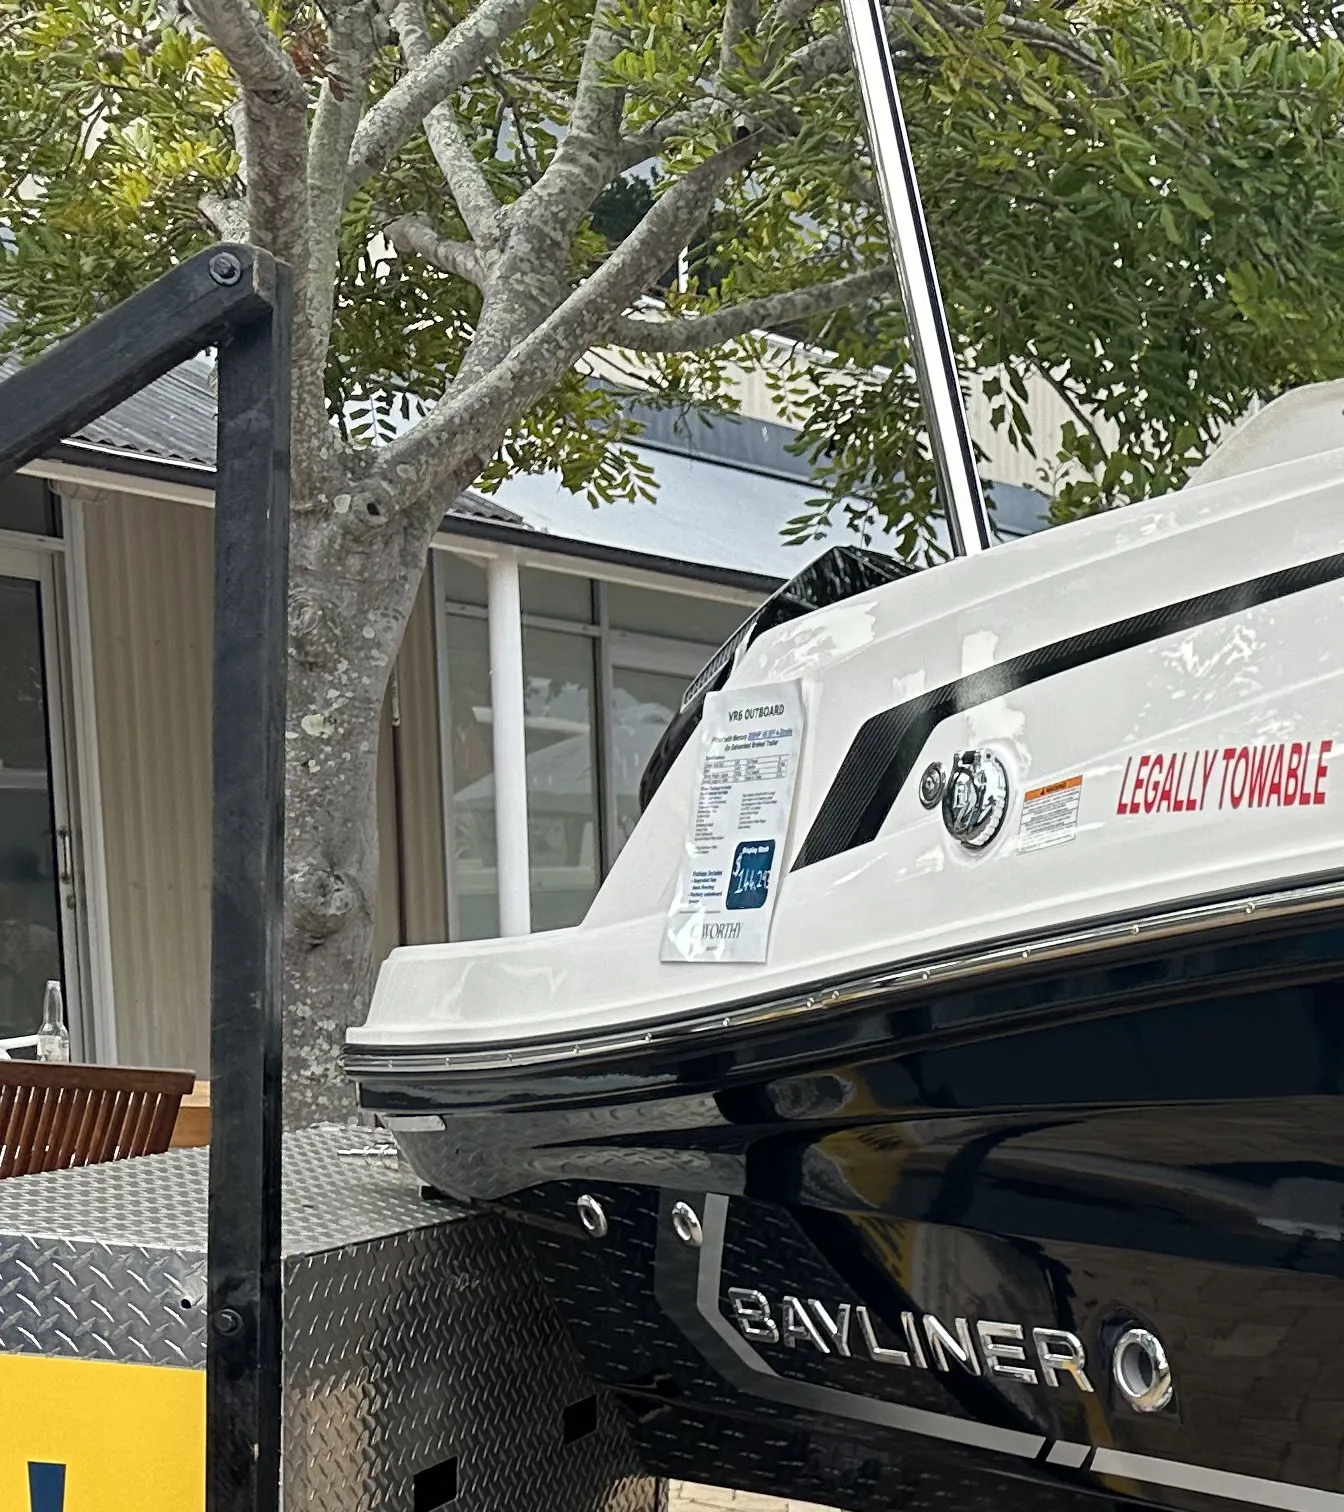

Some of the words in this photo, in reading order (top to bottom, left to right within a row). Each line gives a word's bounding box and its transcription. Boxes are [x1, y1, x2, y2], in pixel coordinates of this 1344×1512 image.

[744, 703, 784, 720] OUTBOARD
[1116, 749, 1219, 815] LEGALLY
[1219, 740, 1333, 810] TOWABLE
[727, 1286, 1095, 1393] BAYLINER
